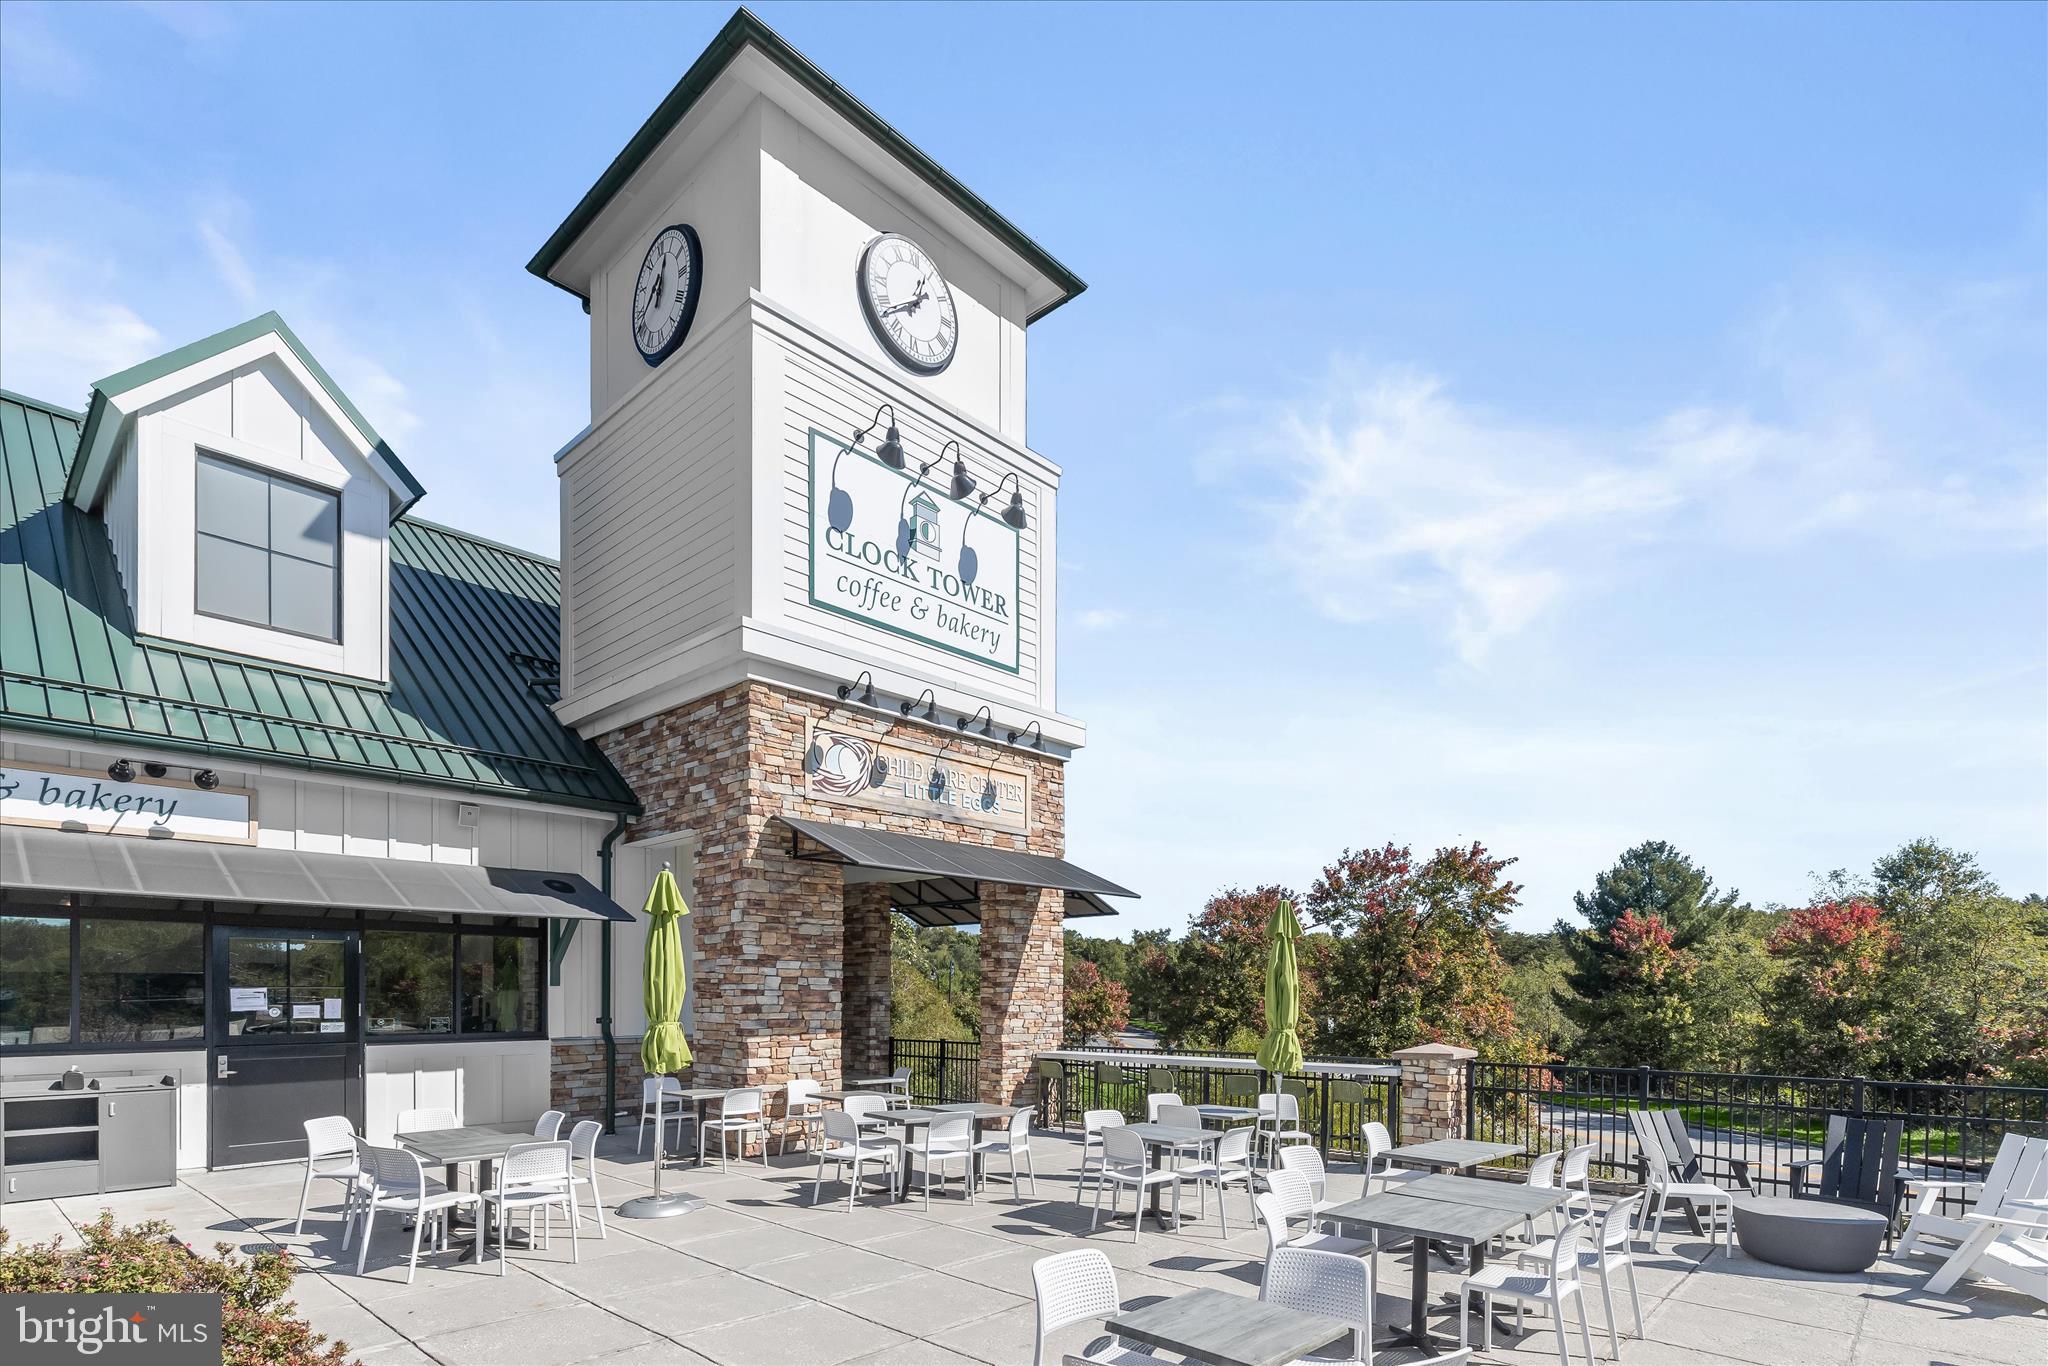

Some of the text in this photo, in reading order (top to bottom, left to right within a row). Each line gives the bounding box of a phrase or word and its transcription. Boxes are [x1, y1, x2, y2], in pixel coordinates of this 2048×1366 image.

[825, 526, 1009, 618] CLOCK TOWER
[837, 574, 1001, 654] coffee & bakery
[38, 777, 178, 826] bakery
[875, 755, 1024, 803] CHILD CARE CENTER
[904, 781, 956, 806] LITTLE
